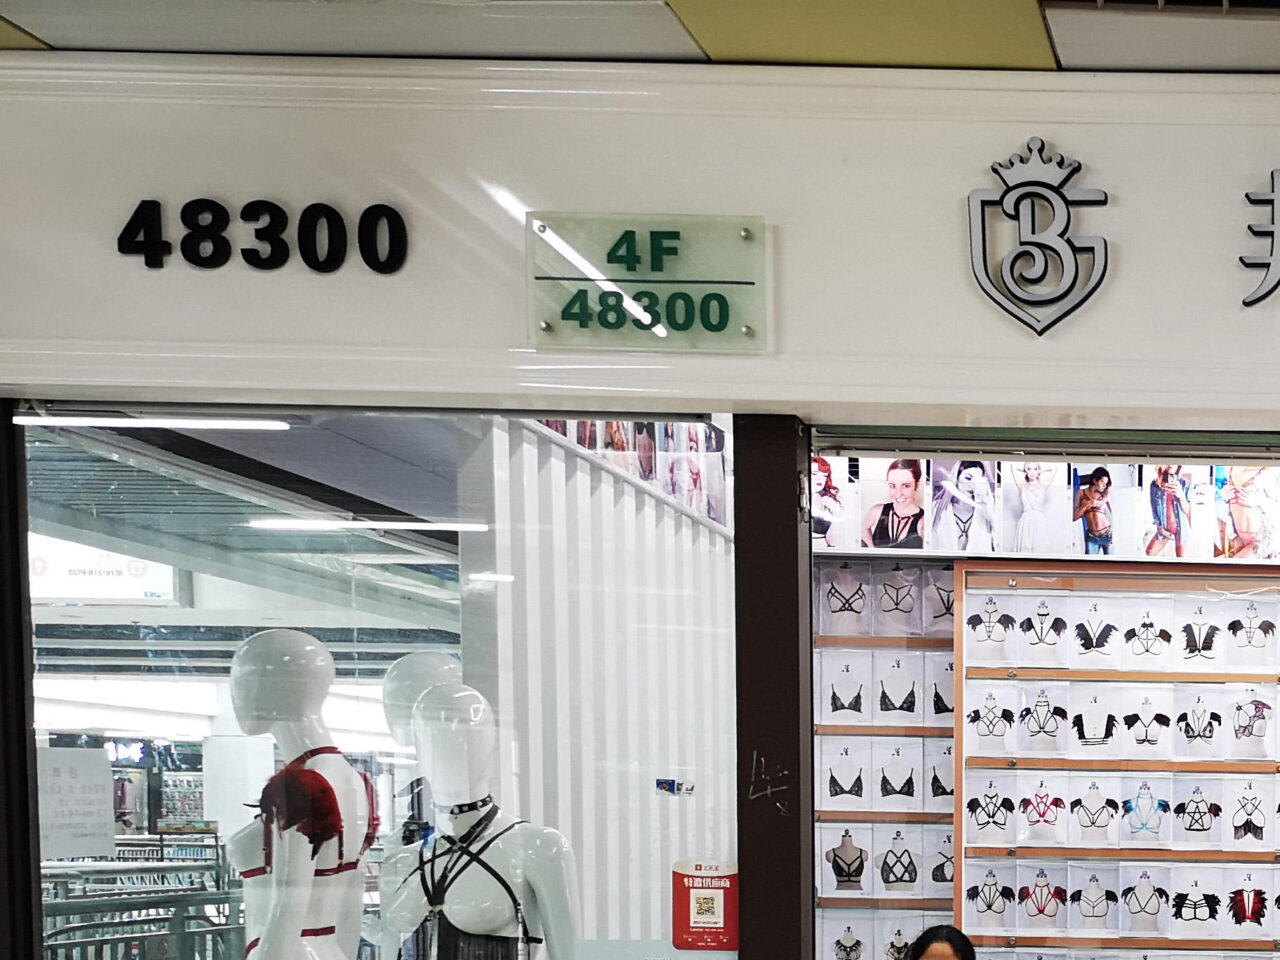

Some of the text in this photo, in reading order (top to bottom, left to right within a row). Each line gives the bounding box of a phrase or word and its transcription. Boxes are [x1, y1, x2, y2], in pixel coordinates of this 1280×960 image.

[116, 198, 410, 275] 48300
[607, 230, 682, 273] 4F
[560, 290, 731, 334] 48300
